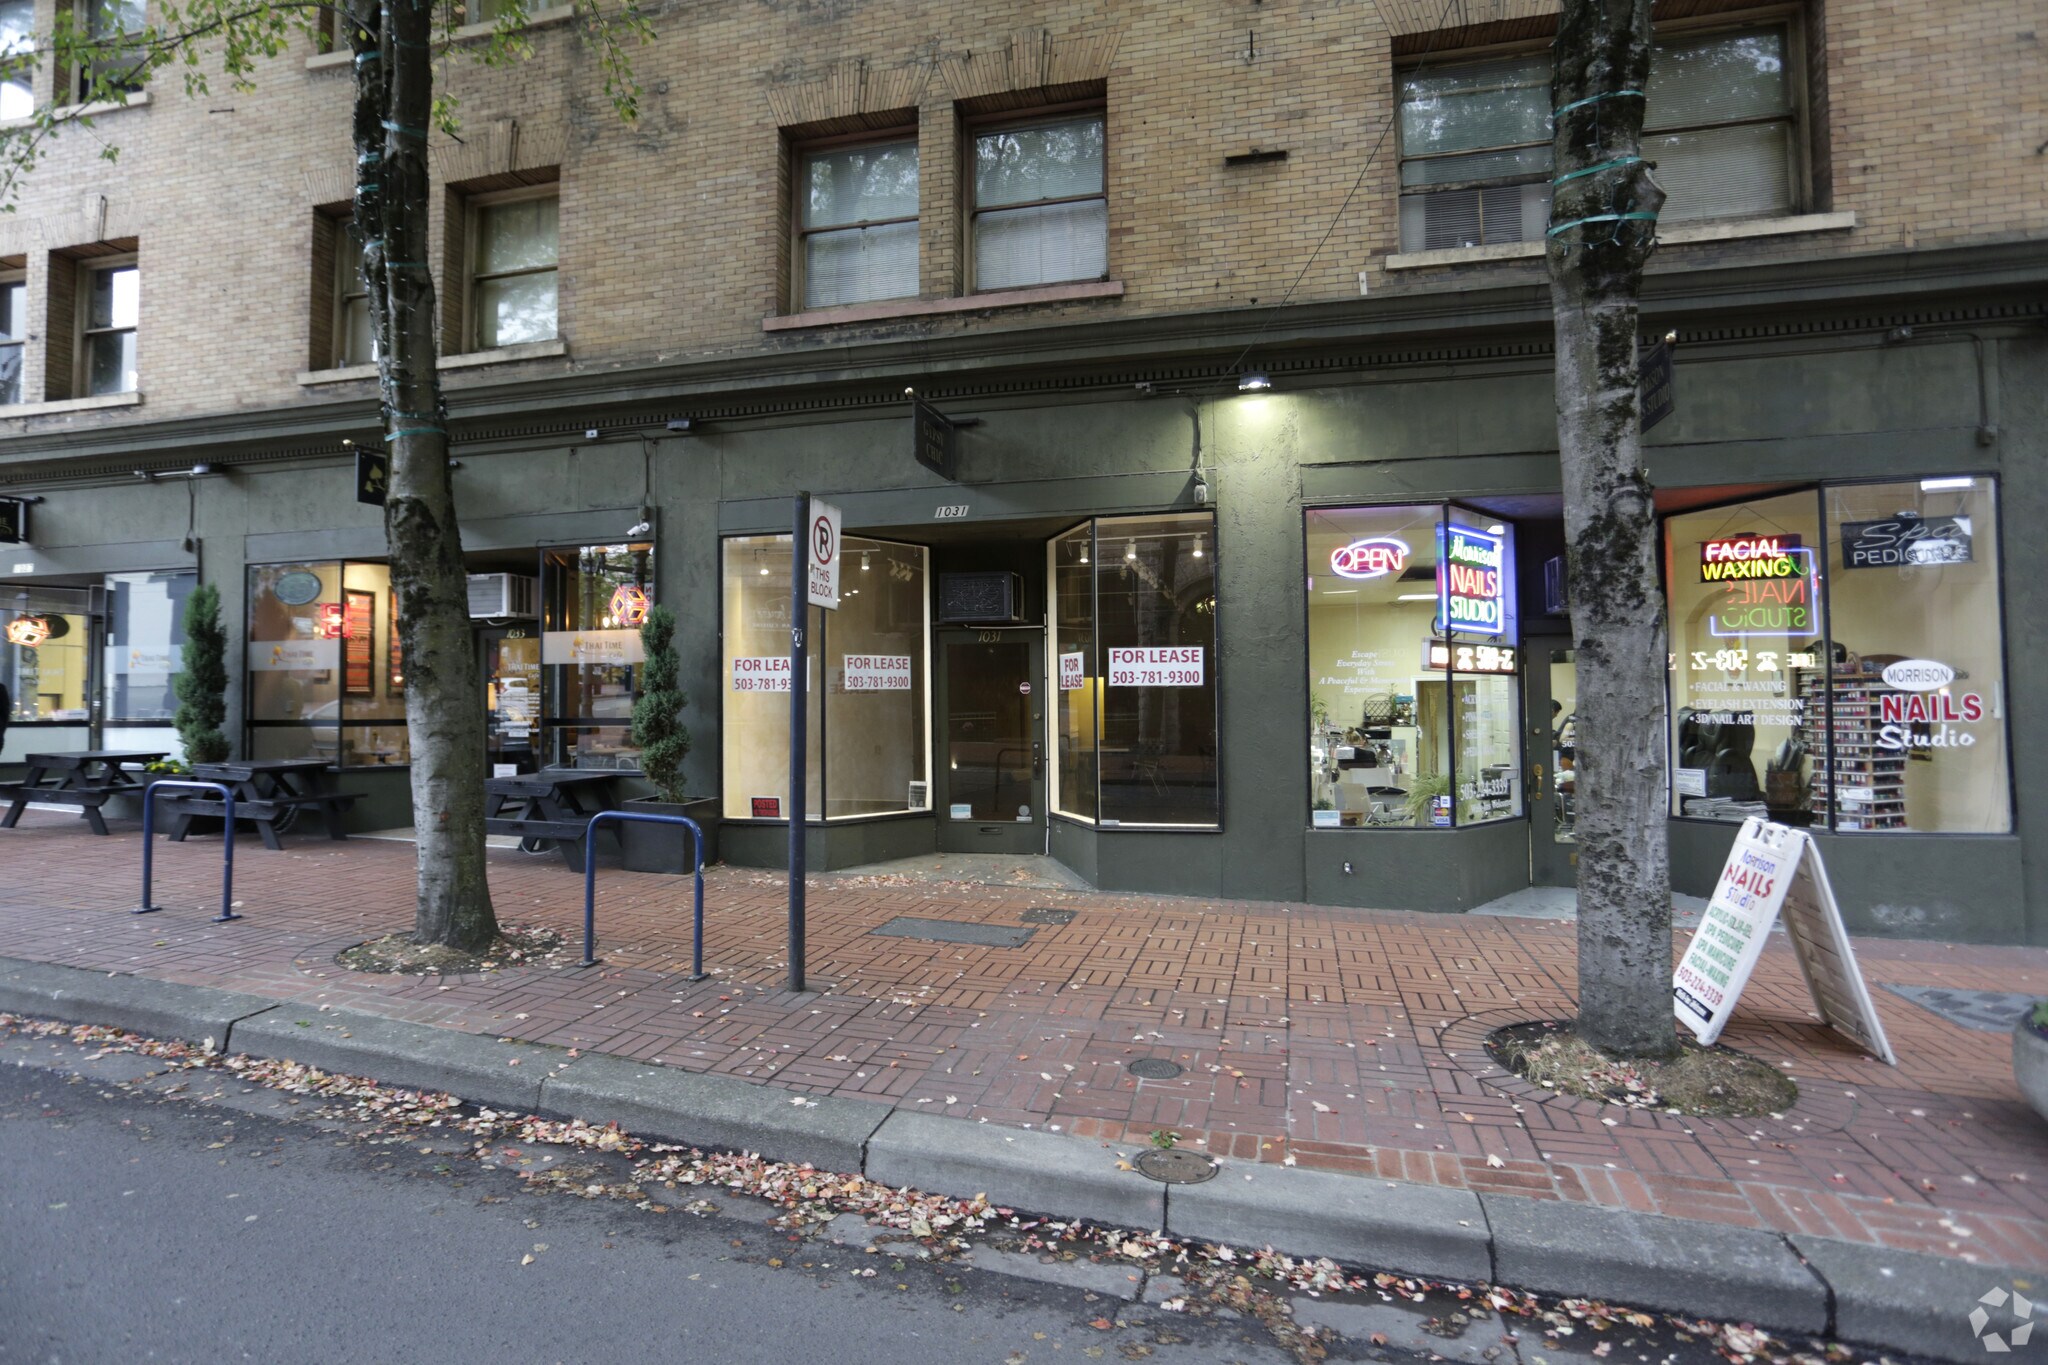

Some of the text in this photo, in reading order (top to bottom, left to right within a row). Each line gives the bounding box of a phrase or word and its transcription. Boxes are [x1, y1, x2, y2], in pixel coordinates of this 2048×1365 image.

[938, 506, 966, 517] 1031
[1705, 539, 1786, 562] FACIAL
[1853, 545, 1968, 565] PEDICURE
[1331, 547, 1403, 571] OPEN
[815, 566, 830, 583] THIS
[1702, 557, 1792, 580] WAXING
[1449, 563, 1497, 597] NAILS
[811, 581, 833, 599] BLOCK
[1450, 595, 1497, 623] STUDIO
[978, 631, 1001, 643] 1031
[605, 641, 623, 650] TIME
[847, 657, 908, 670] FOR LEASE
[1113, 650, 1200, 664] FOR LEASE
[735, 659, 791, 671] FOR LEA
[1064, 658, 1079, 672] FOR
[847, 676, 909, 688] 503-781-9300
[1061, 675, 1083, 689] LEASE
[1113, 671, 1200, 684] 503-781-9300
[1887, 668, 1949, 682] MORRISON
[735, 678, 791, 690] 503-781-93
[1695, 681, 1787, 692] FACIAL & WAXING
[1695, 699, 1804, 710] EYELASH EXTENSION
[1880, 693, 1983, 723] NAILS
[1737, 714, 1755, 725] ART
[1761, 714, 1803, 726] DESIGN
[1876, 724, 1976, 749] Studio
[753, 799, 778, 809] POSTED
[1723, 863, 1775, 899] NAILS
